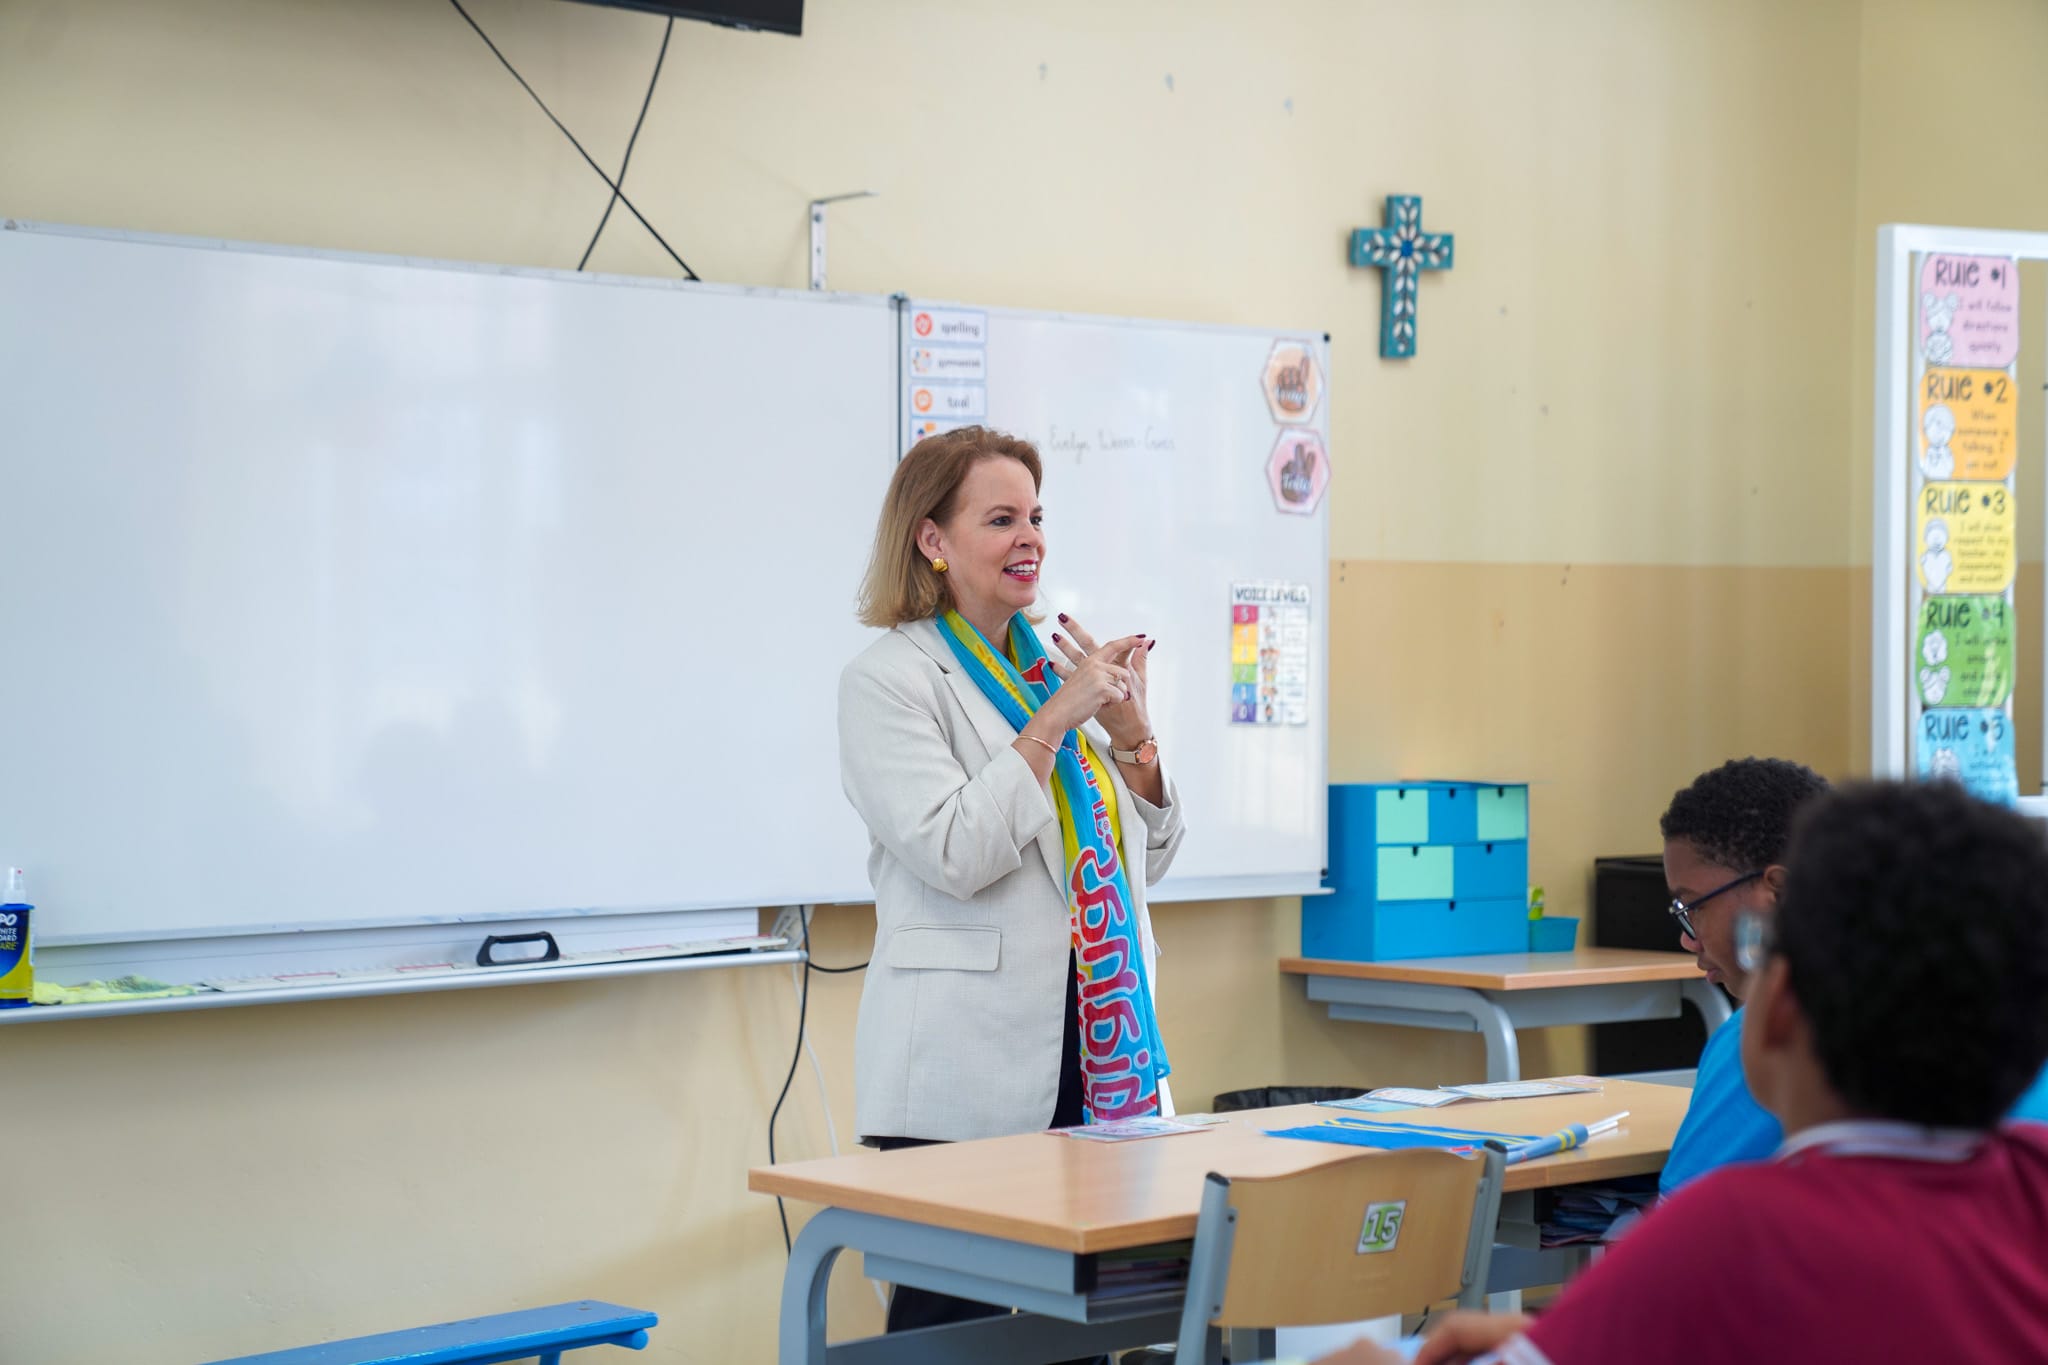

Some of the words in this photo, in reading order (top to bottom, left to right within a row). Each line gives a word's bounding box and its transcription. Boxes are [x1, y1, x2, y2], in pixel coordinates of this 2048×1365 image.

[1934, 257, 1980, 288] Rule
[941, 320, 980, 338] spelling
[1926, 374, 1973, 401] Rule
[1925, 487, 1971, 515] Rule
[1925, 601, 1971, 629] Rule
[1924, 713, 1970, 741] Rule
[1362, 1209, 1402, 1245] 15
